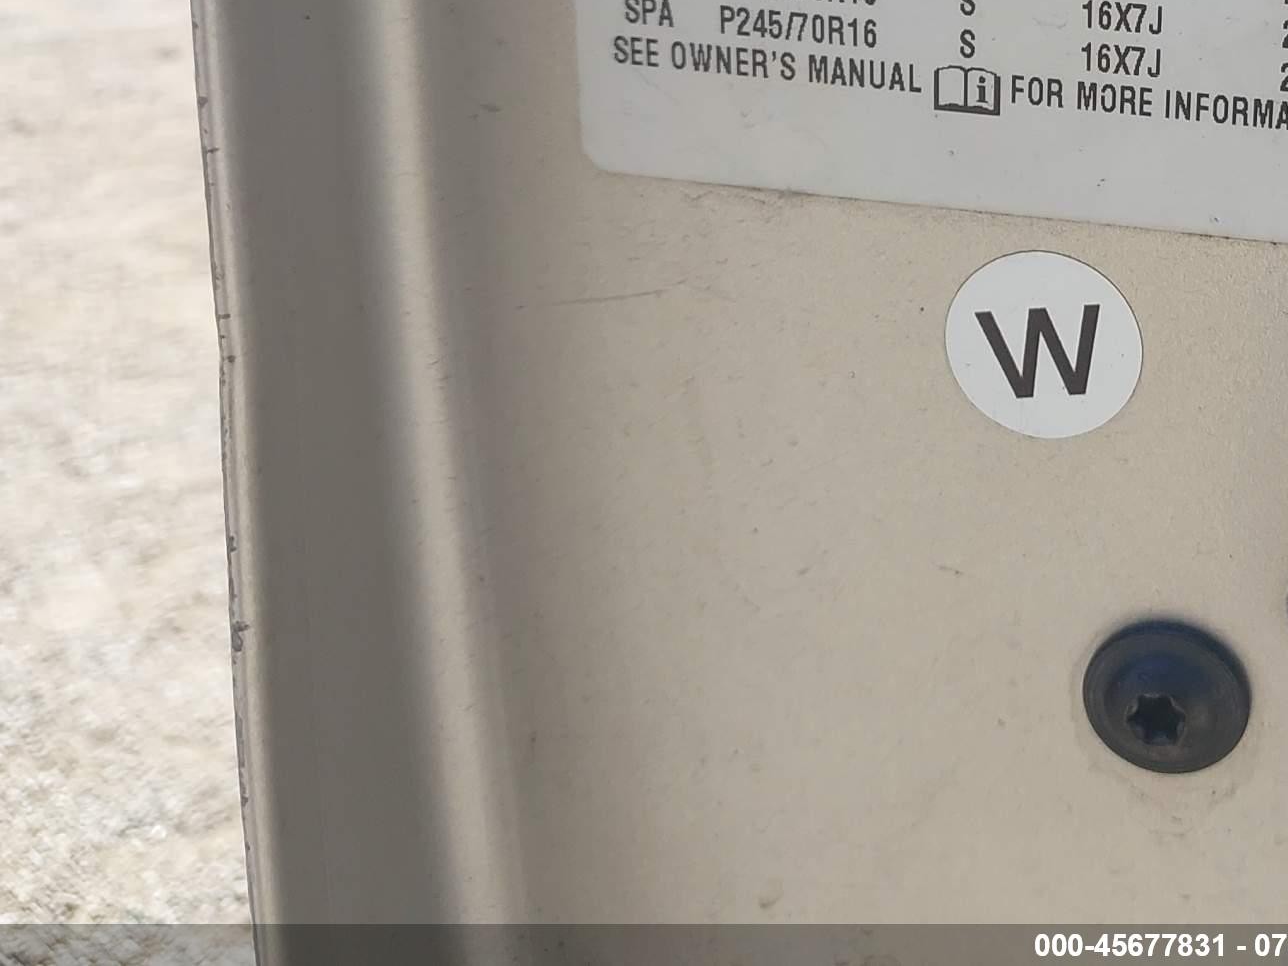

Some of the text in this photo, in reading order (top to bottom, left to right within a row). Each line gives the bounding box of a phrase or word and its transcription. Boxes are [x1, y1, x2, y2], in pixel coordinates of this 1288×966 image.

[720, 5, 876, 48] P245/70R16
[960, 29, 975, 58] S
[1081, 42, 1161, 77] 16X7J
[1082, 0, 1162, 34] 16X7J
[614, 36, 658, 67] SEE
[671, 42, 795, 80] OWNER'S
[809, 55, 921, 93] MANUAL
[1012, 75, 1063, 108] FOR
[1077, 81, 1152, 116] MORE
[974, 304, 1100, 398] W
